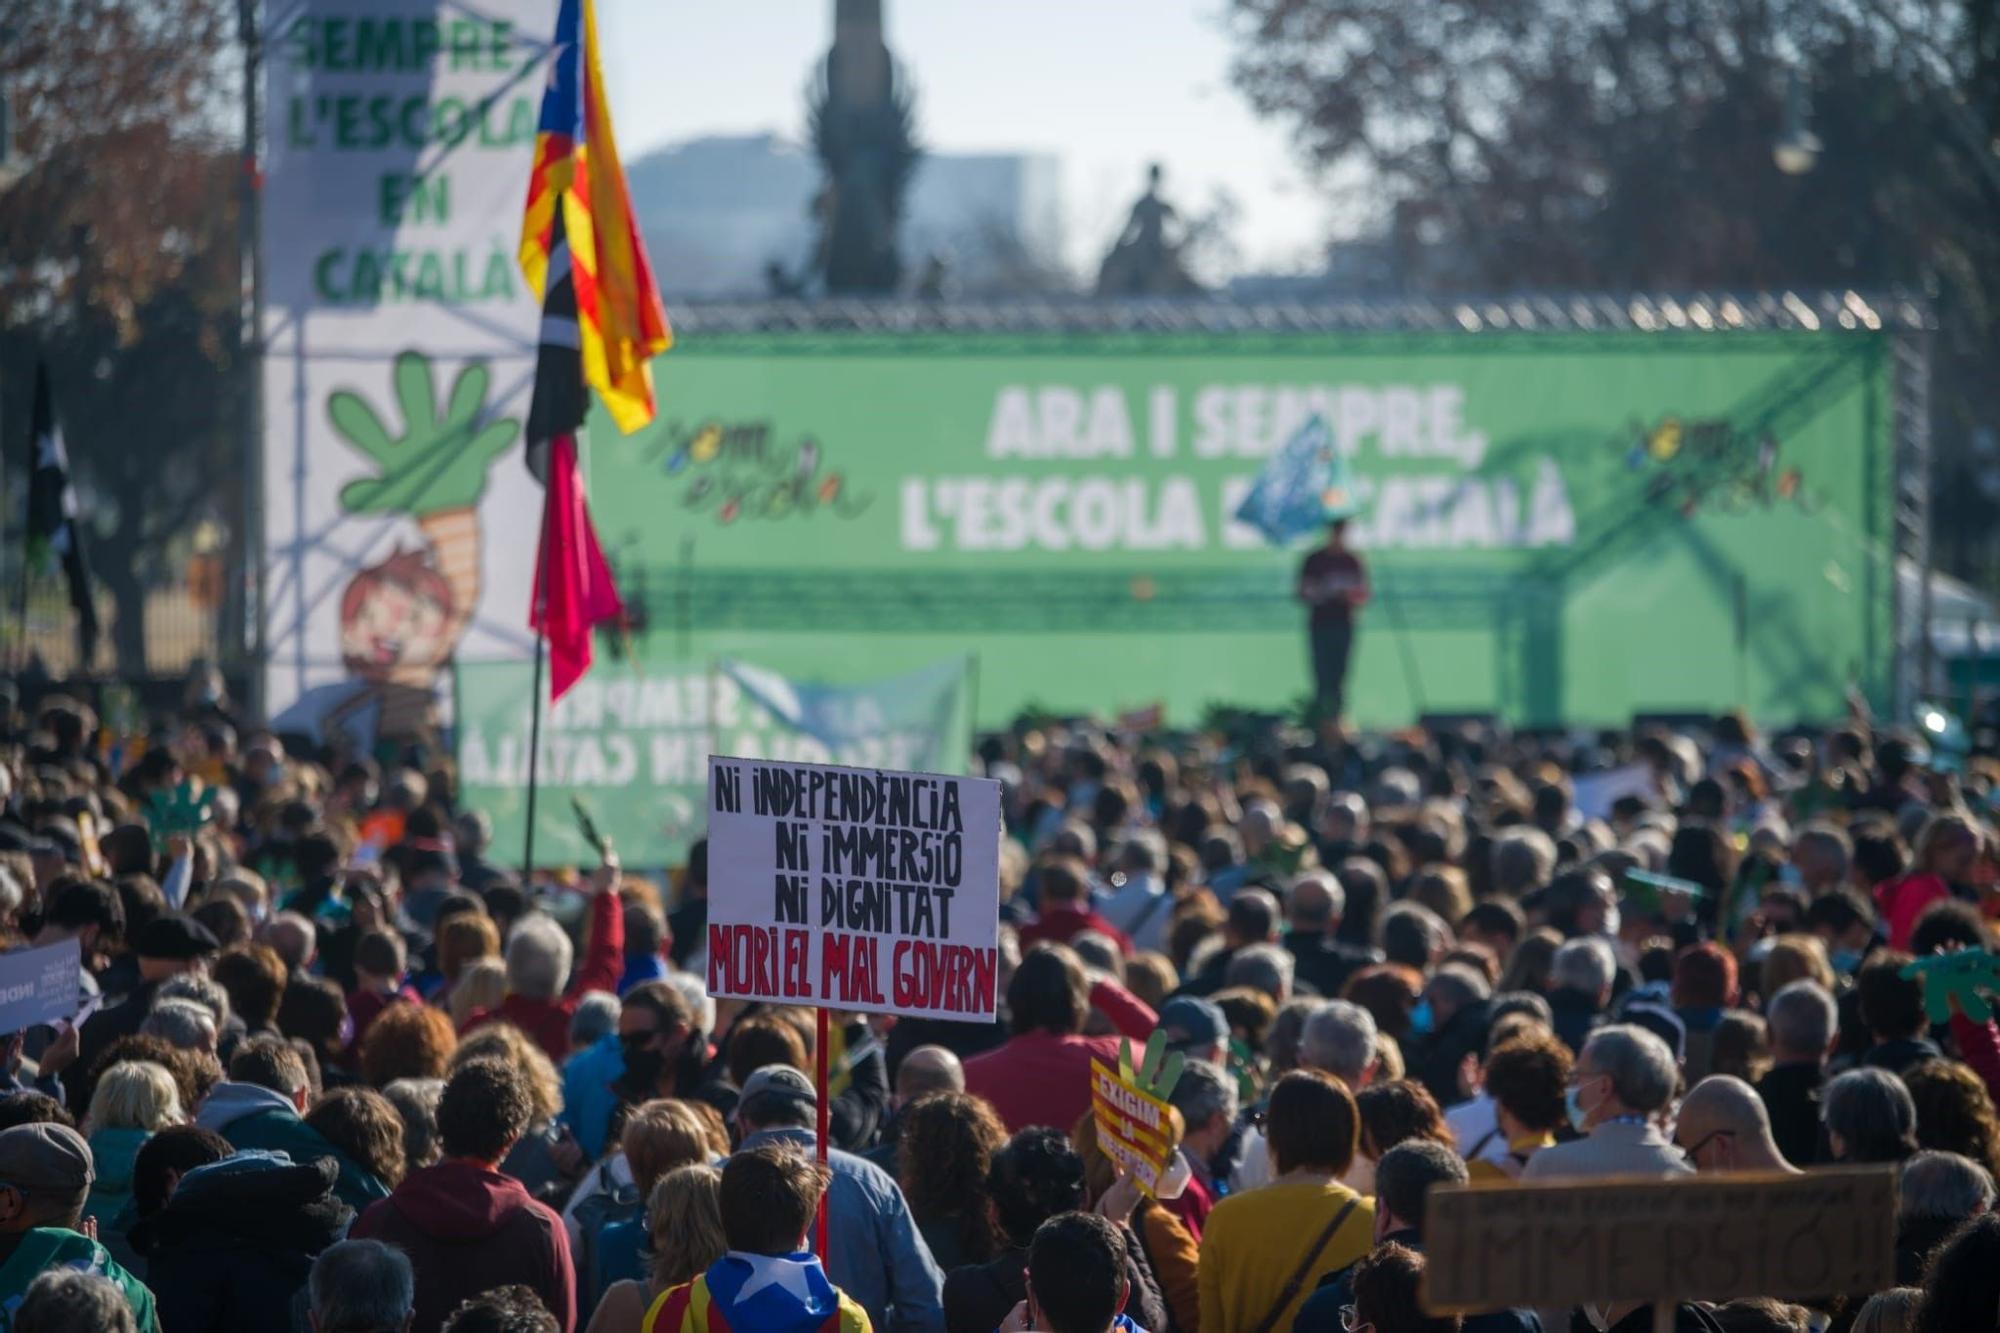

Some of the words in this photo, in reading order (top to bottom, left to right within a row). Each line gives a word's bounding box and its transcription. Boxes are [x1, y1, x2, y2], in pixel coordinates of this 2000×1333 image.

[379, 172, 451, 225] EN
[985, 386, 1132, 458] ARA
[1148, 386, 1177, 457] I
[900, 476, 1206, 550] L'ESCOLA
[784, 928, 812, 997] EL
[821, 932, 885, 1004] MAL
[893, 940, 997, 1013] GOVERN
[1100, 1074, 1160, 1130] EXIGIM
